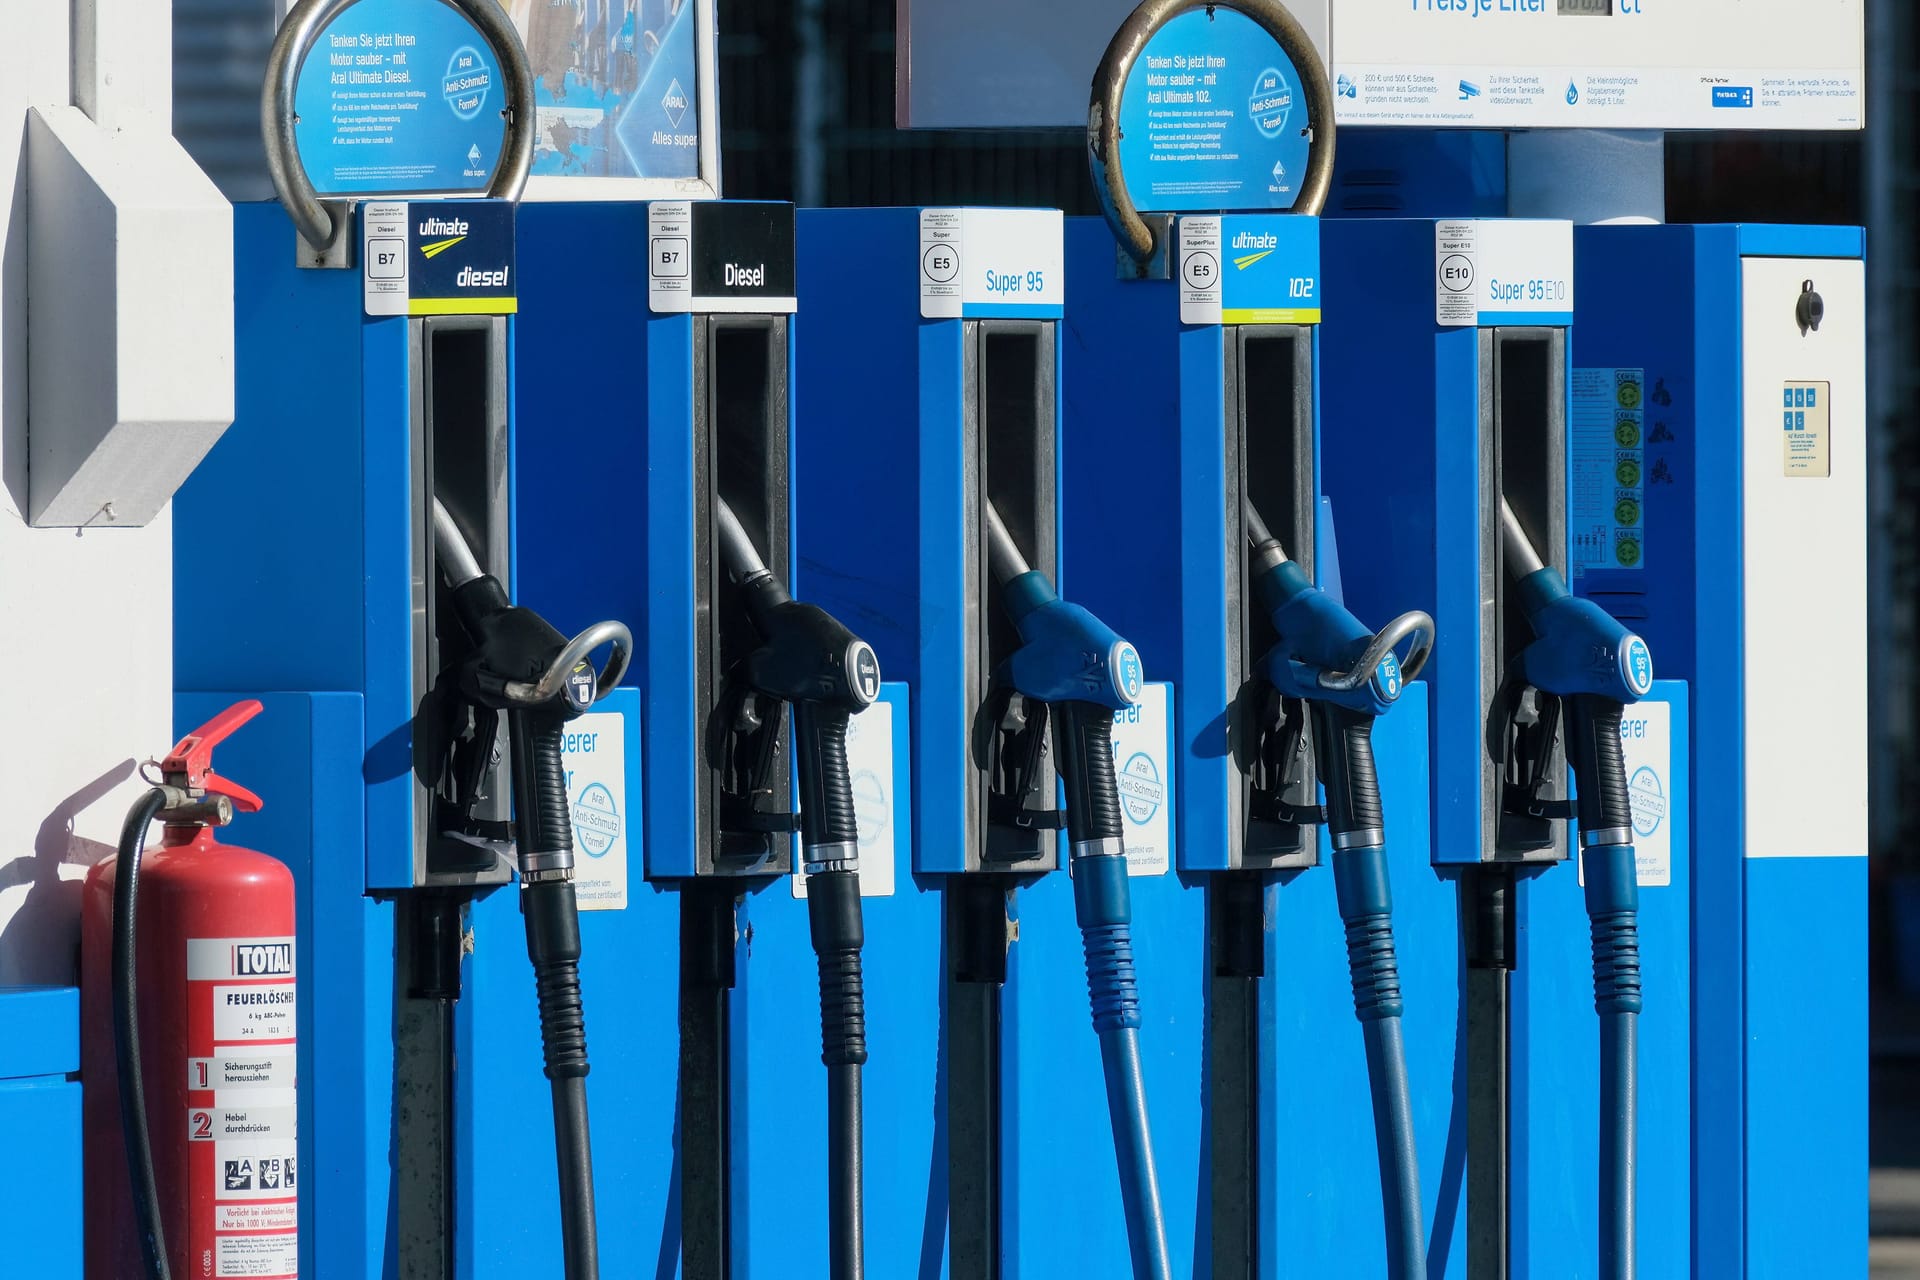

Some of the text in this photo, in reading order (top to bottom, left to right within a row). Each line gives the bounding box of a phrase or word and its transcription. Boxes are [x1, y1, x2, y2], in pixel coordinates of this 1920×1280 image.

[330, 33, 416, 49] Tanken Sie jetzt Ihren
[331, 53, 353, 66] Motor
[356, 52, 383, 65] sauber
[393, 51, 406, 64] mit
[460, 56, 472, 68] Aral
[1146, 56, 1226, 70] Tanken Sie jetzt Ihren
[331, 70, 411, 84] Aral Ultimate Diesel.
[446, 74, 489, 94] Anti-Schmutz
[1147, 73, 1216, 86] Motor sauber mit
[458, 96, 478, 110] Formel
[665, 96, 684, 108] ARAL
[1147, 90, 1212, 104] Aral Ultimate 102.
[1252, 94, 1290, 113] Anti-Schmutz
[1263, 115, 1281, 128] Formel
[652, 131, 672, 145] Alles
[419, 217, 469, 236] ultimate
[1232, 232, 1277, 249] ultimate
[378, 253, 396, 264] B7
[661, 252, 679, 264] B7
[933, 258, 950, 269] E5
[456, 266, 509, 287] diesel
[725, 263, 764, 287] Diesel
[1193, 265, 1210, 276] E5
[1445, 268, 1469, 279] E10
[986, 269, 1043, 296] Super 95
[1289, 278, 1314, 297] 102
[1490, 279, 1524, 304] Super
[1384, 665, 1396, 677] 102
[1136, 761, 1148, 774] Aral
[1120, 778, 1160, 799] Anti-Schmutz
[591, 791, 605, 805] Aral
[1129, 801, 1148, 816] Formel
[574, 810, 618, 831] Anti-Schmutz
[585, 832, 604, 848] Formel
[239, 946, 290, 974] TOTAL
[224, 1061, 272, 1073] Sicherungsstift
[196, 1062, 208, 1087] 1
[224, 1073, 270, 1083] herausziehen
[225, 1113, 247, 1122] Hebel
[192, 1112, 212, 1138] 2
[225, 1124, 271, 1134] durchdrücken
[240, 1160, 253, 1172] A
[272, 1159, 279, 1172] B
[226, 1208, 249, 1216] Vorsicht
[248, 1219, 259, 1227] 1000
